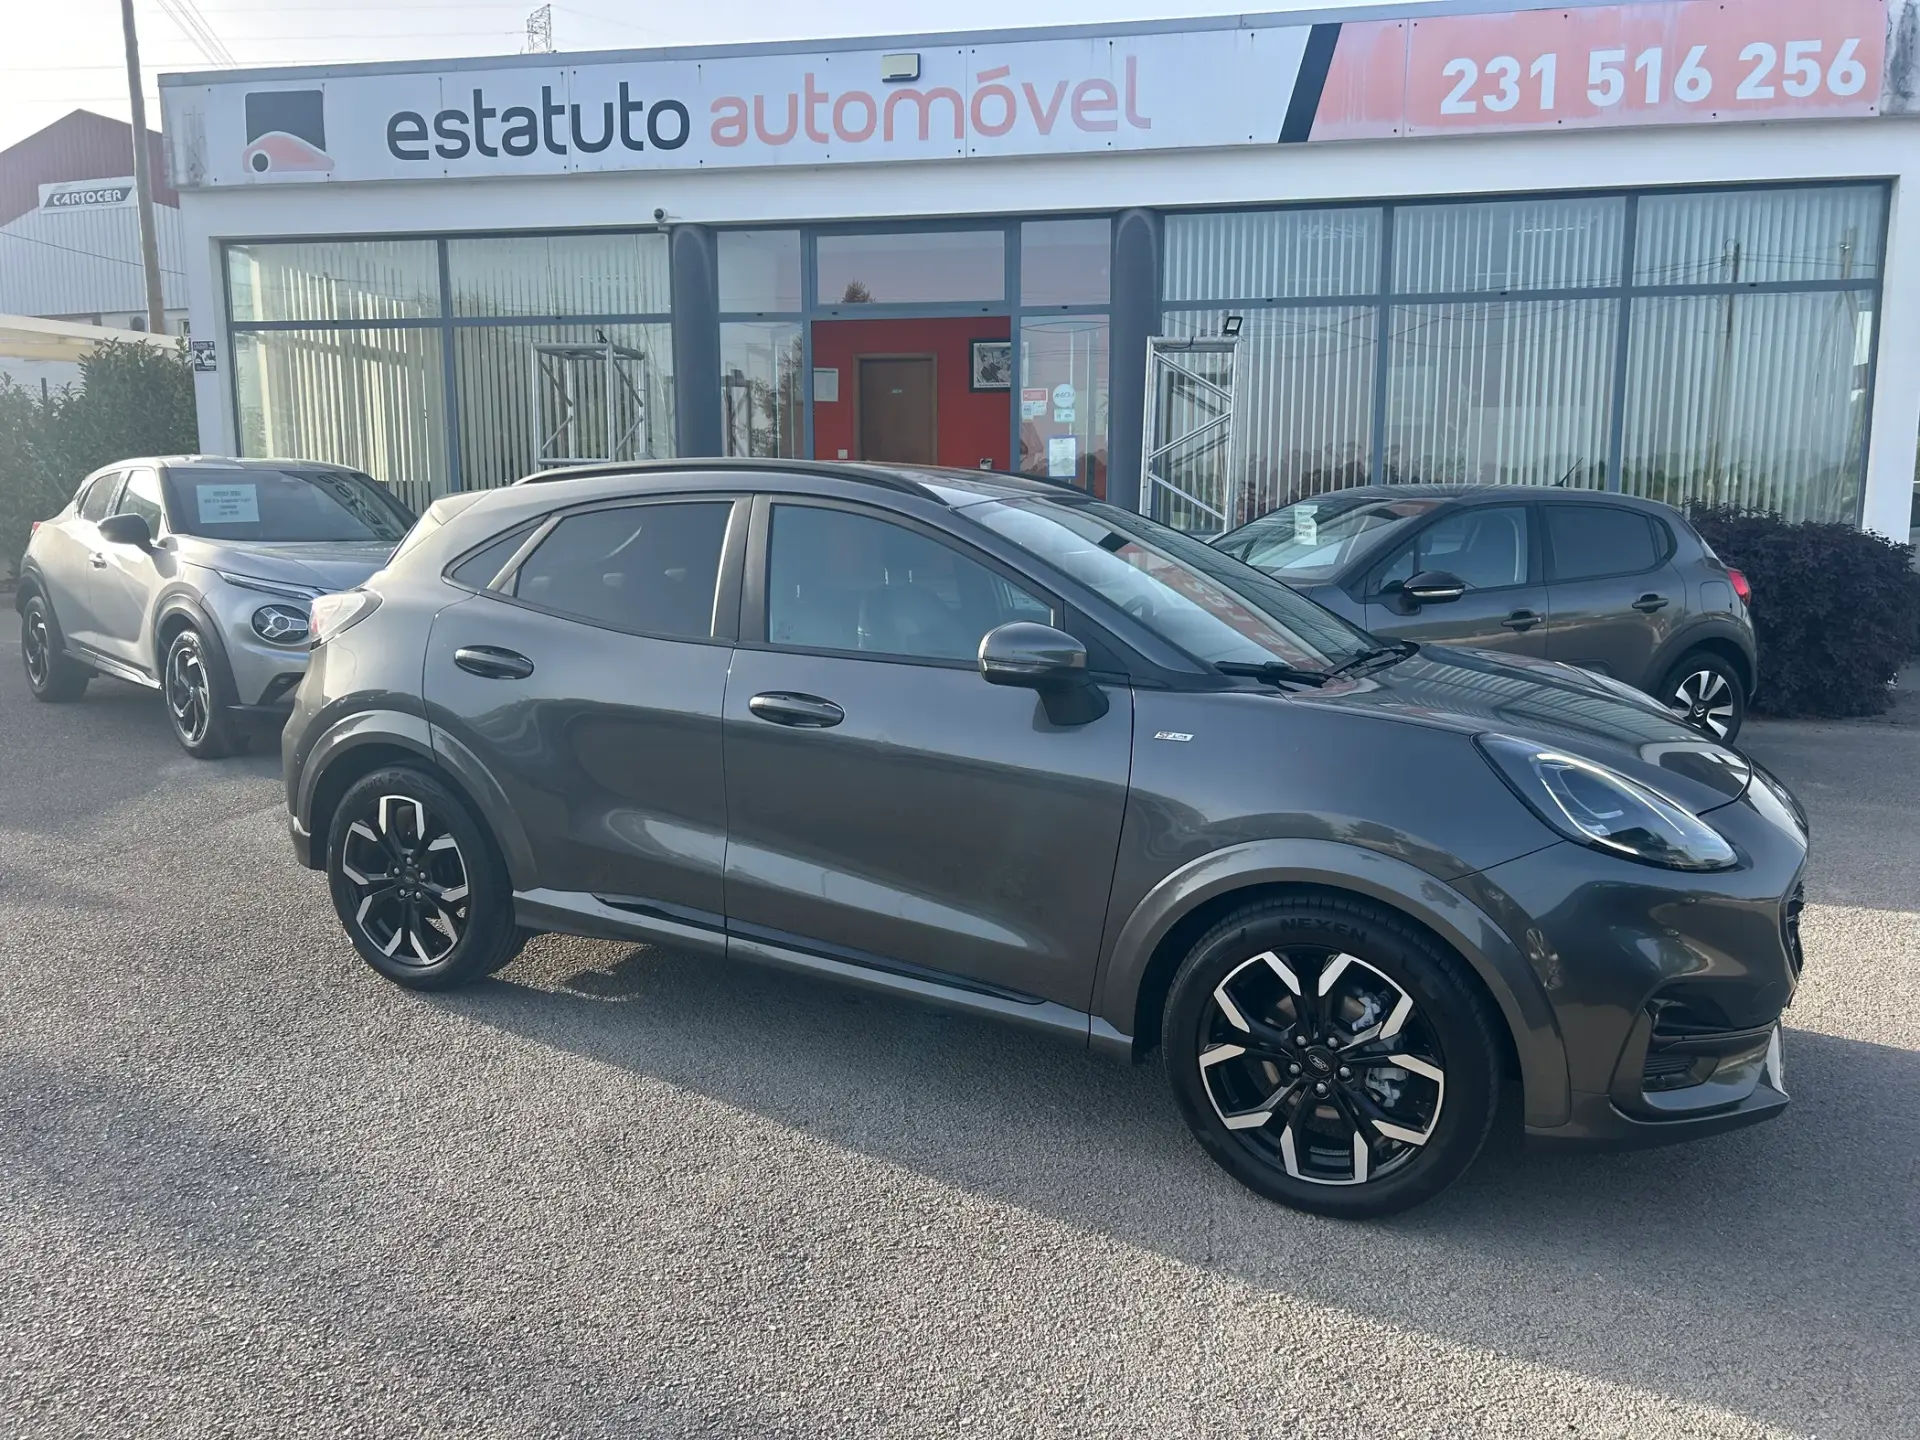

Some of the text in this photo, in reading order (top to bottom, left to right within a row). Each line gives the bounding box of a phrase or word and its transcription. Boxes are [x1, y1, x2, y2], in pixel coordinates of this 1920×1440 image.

[1440, 38, 1866, 114] 231 516 256
[387, 55, 1151, 160] estatuto automóvel
[53, 189, 122, 206] CARTOCER
[1279, 917, 1367, 943] NEXEN
